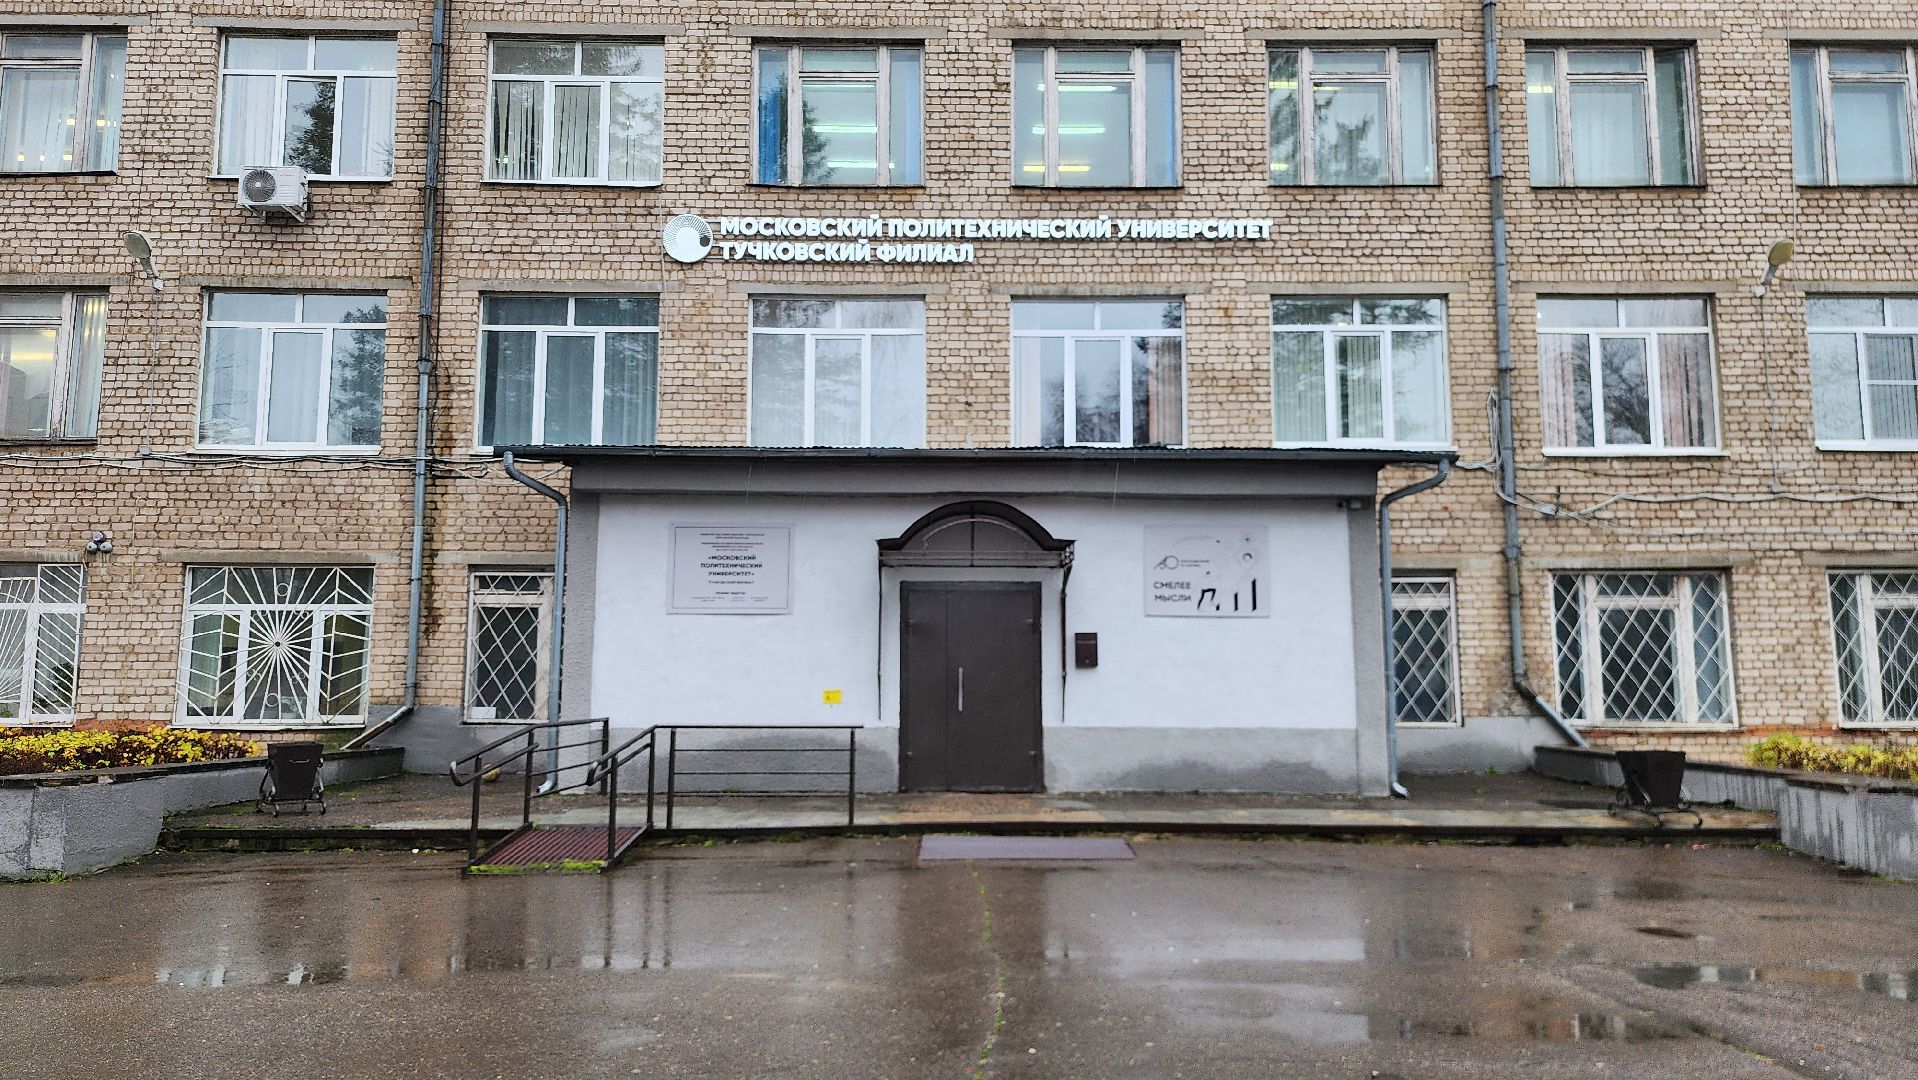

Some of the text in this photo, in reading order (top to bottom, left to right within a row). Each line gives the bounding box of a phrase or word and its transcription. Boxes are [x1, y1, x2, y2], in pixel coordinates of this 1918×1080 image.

[719, 214, 1274, 239] МОСКОВСКИЙ ПОЛИТЕХНИЧЕСКИЙ УНИВЕРСИТЕТ
[720, 239, 975, 263] ТУЧКОВСКИЙ ФИЛИАЛ
[1153, 581, 1191, 589] СМЕЛЕЕ
[1154, 594, 1191, 602] МЫСЛИ
